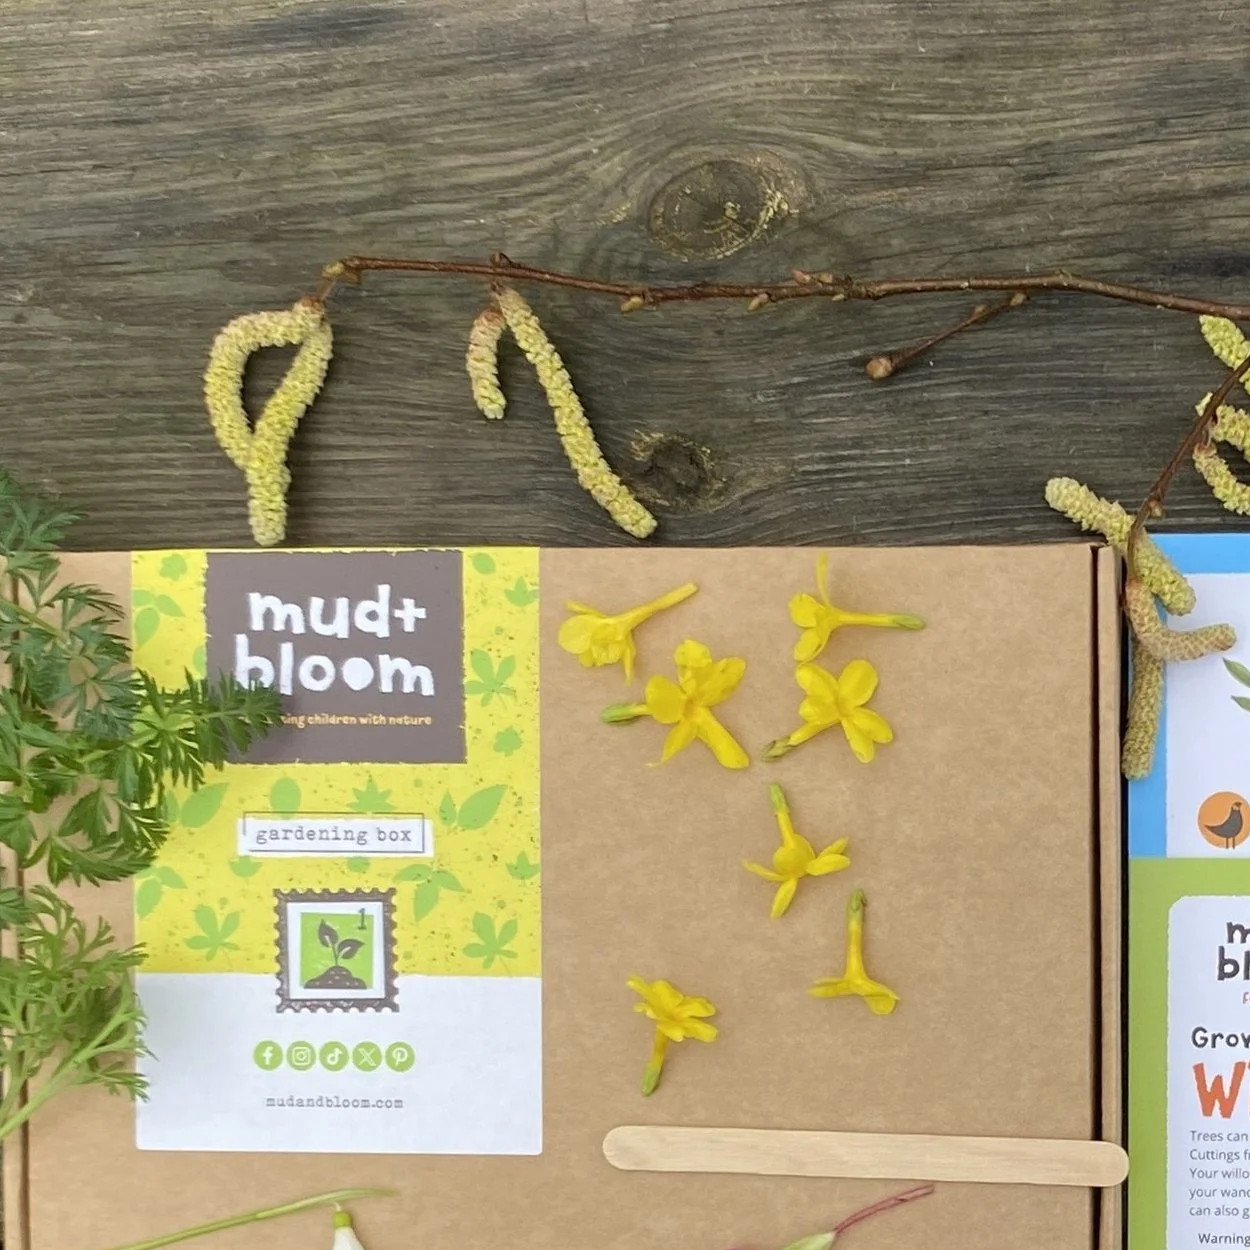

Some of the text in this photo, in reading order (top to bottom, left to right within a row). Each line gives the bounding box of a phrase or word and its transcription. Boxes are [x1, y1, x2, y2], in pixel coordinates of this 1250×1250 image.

[248, 584, 426, 638] mud+
[234, 633, 434, 695] bloom
[307, 713, 356, 724] children
[358, 713, 386, 724] with
[387, 715, 431, 725] nature
[256, 825, 411, 845] gardening box
[266, 1095, 403, 1108] mudandbloom.com
[1189, 1130, 1223, 1141] Trees
[1226, 1133, 1248, 1142] can
